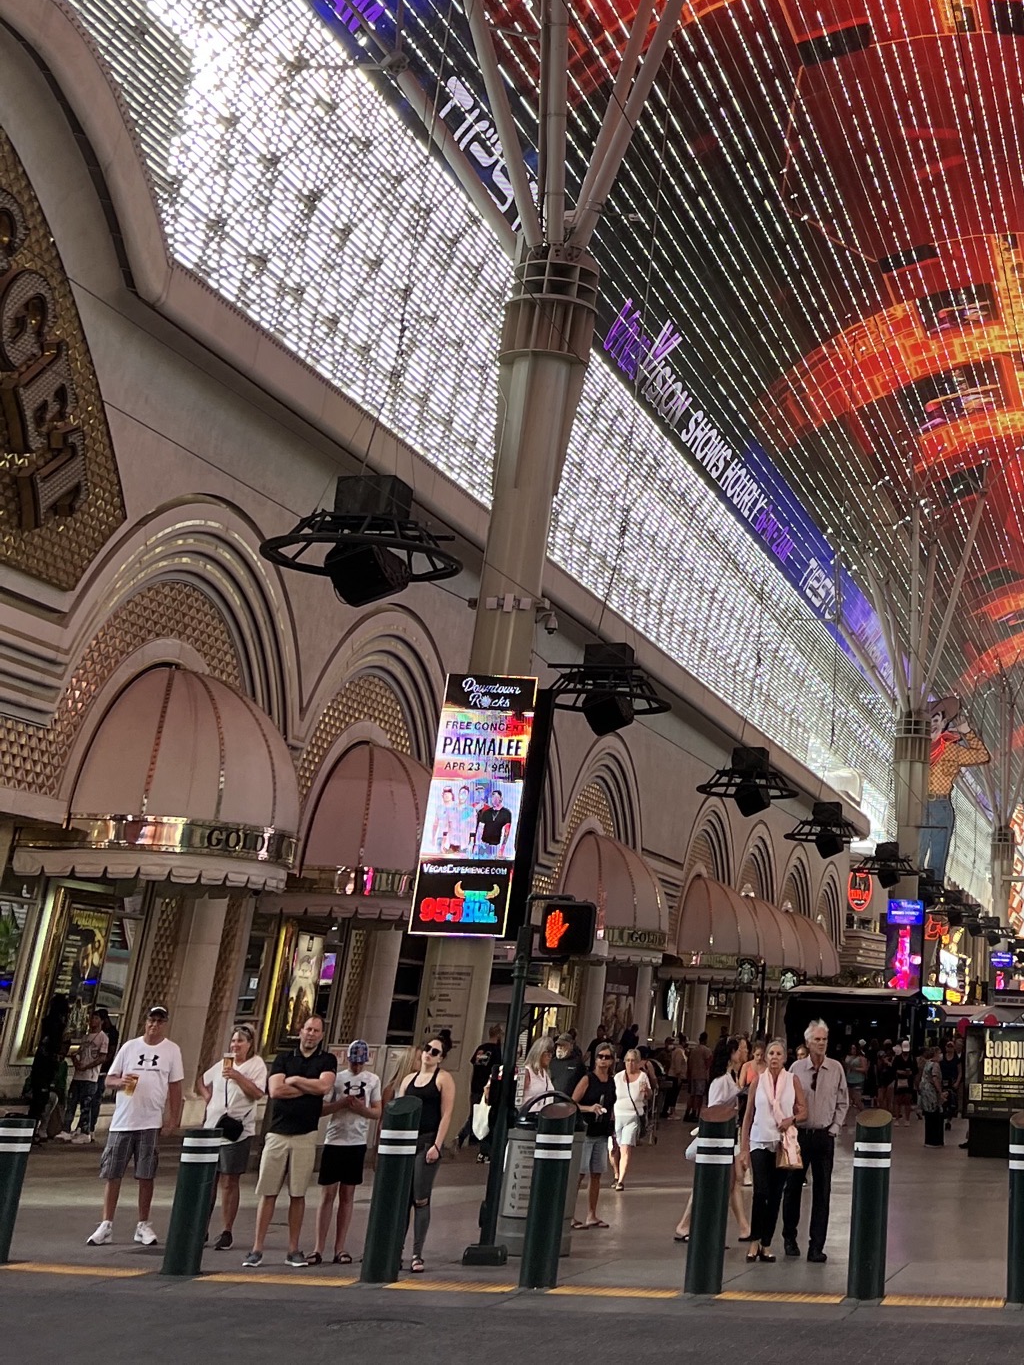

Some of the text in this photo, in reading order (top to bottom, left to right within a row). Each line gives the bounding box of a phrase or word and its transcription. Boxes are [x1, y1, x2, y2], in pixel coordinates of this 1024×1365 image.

[681, 409, 733, 480] SHOWS
[718, 457, 768, 523] HOURLY
[462, 677, 521, 695] Downtown
[445, 720, 527, 732] FREE CONCERT
[441, 736, 524, 757] PARMALEE
[444, 761, 465, 772] APR
[467, 761, 482, 772] 23
